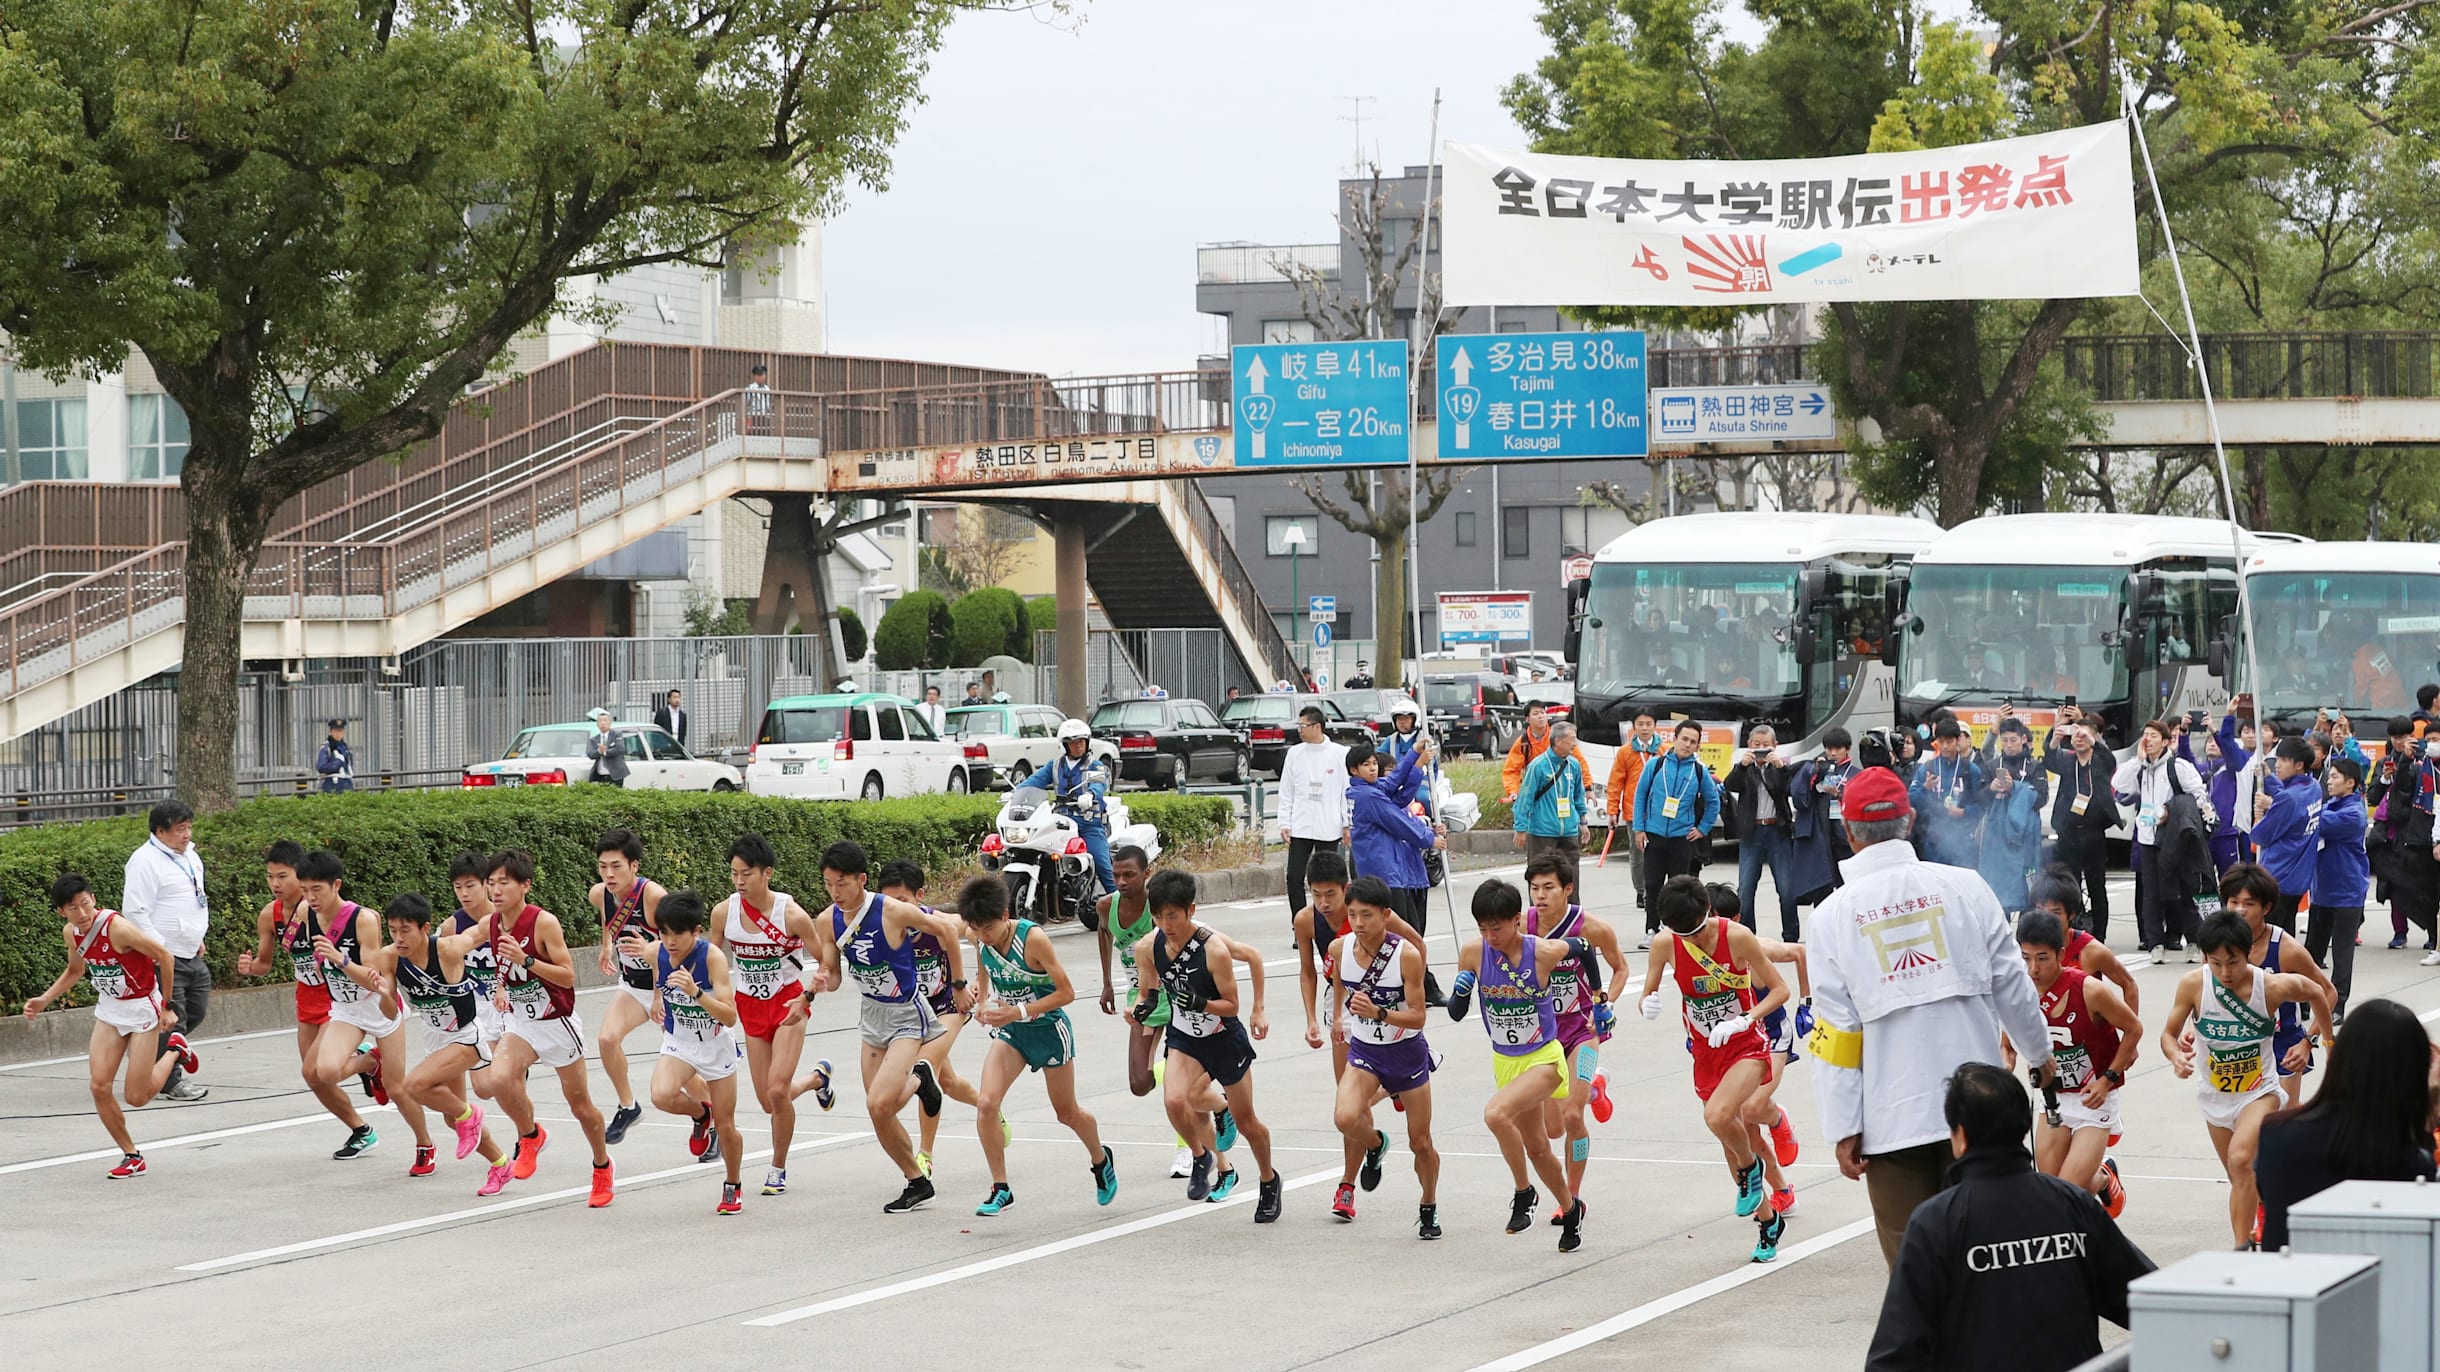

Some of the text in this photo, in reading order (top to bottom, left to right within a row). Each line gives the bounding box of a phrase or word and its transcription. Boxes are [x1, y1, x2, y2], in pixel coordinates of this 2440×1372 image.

[1491, 154, 2073, 230] 全日本大学駅伝出発点
[1738, 264, 1770, 291] 朝
[1827, 277, 1853, 286] asahi
[1487, 340, 1577, 373] 多治見
[1281, 351, 1341, 381] 岐阜
[1297, 384, 1326, 399] Gifu
[1509, 375, 1554, 394] Tajimi
[1451, 393, 1473, 414] 19
[1701, 394, 1794, 417] 熱田神宮
[1249, 402, 1268, 420] 22
[1487, 399, 1577, 431] 春日井
[1282, 409, 1342, 438] 一宮
[1708, 420, 1788, 433] Atsuta Shrine
[1199, 444, 1215, 456] 19
[1504, 434, 1560, 452] Kasugai
[1283, 441, 1342, 460] Ichinomiya
[1458, 610, 1477, 620] 700
[1500, 609, 1520, 619] 300
[1750, 716, 1791, 725] GALA
[1855, 893, 1943, 927] 全日本大学駅伝
[731, 945, 785, 957] 阪経済大学
[748, 961, 780, 971] JAバンク
[303, 972, 320, 985] 11
[102, 987, 119, 997] 14
[342, 990, 358, 1001] 17
[749, 984, 770, 998] 23
[1001, 985, 1031, 997] JAバンク
[1700, 992, 1736, 1009] JAバンク
[525, 1004, 536, 1019] 9
[1499, 1005, 1535, 1016] JAバンク
[1693, 1005, 1735, 1022] 城西大
[677, 1017, 716, 1029] 神奈川大
[1192, 1022, 1203, 1036] 5
[1488, 1015, 1535, 1029] 中央学院大
[695, 1030, 704, 1042] 1
[1373, 1027, 1384, 1041] 4
[1506, 1029, 1519, 1044] 6
[2222, 1048, 2259, 1062] JAバンク
[2219, 1075, 2245, 1093] 27
[1966, 1232, 2087, 1272] CITIZEN
